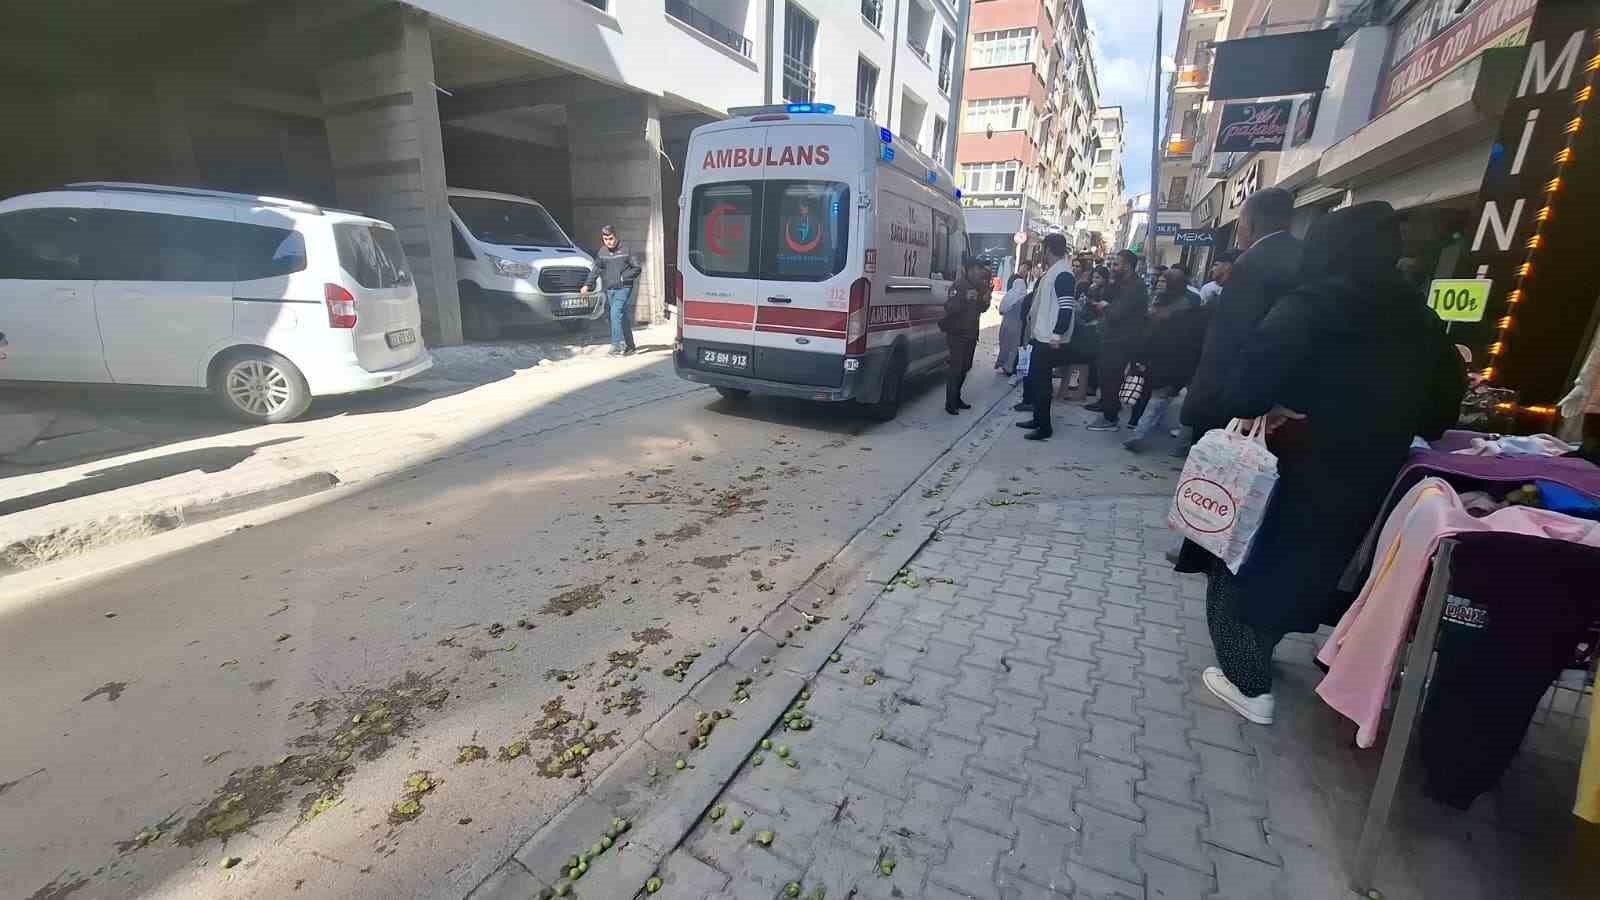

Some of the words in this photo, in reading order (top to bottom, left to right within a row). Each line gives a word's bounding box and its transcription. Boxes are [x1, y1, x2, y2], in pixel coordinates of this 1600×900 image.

[702, 144, 830, 170] AMBULANS
[830, 287, 846, 300] 112
[869, 305, 911, 324] AMBULANS
[704, 351, 716, 362] 23
[732, 354, 747, 366] 913
[1183, 487, 1229, 517] eczane
